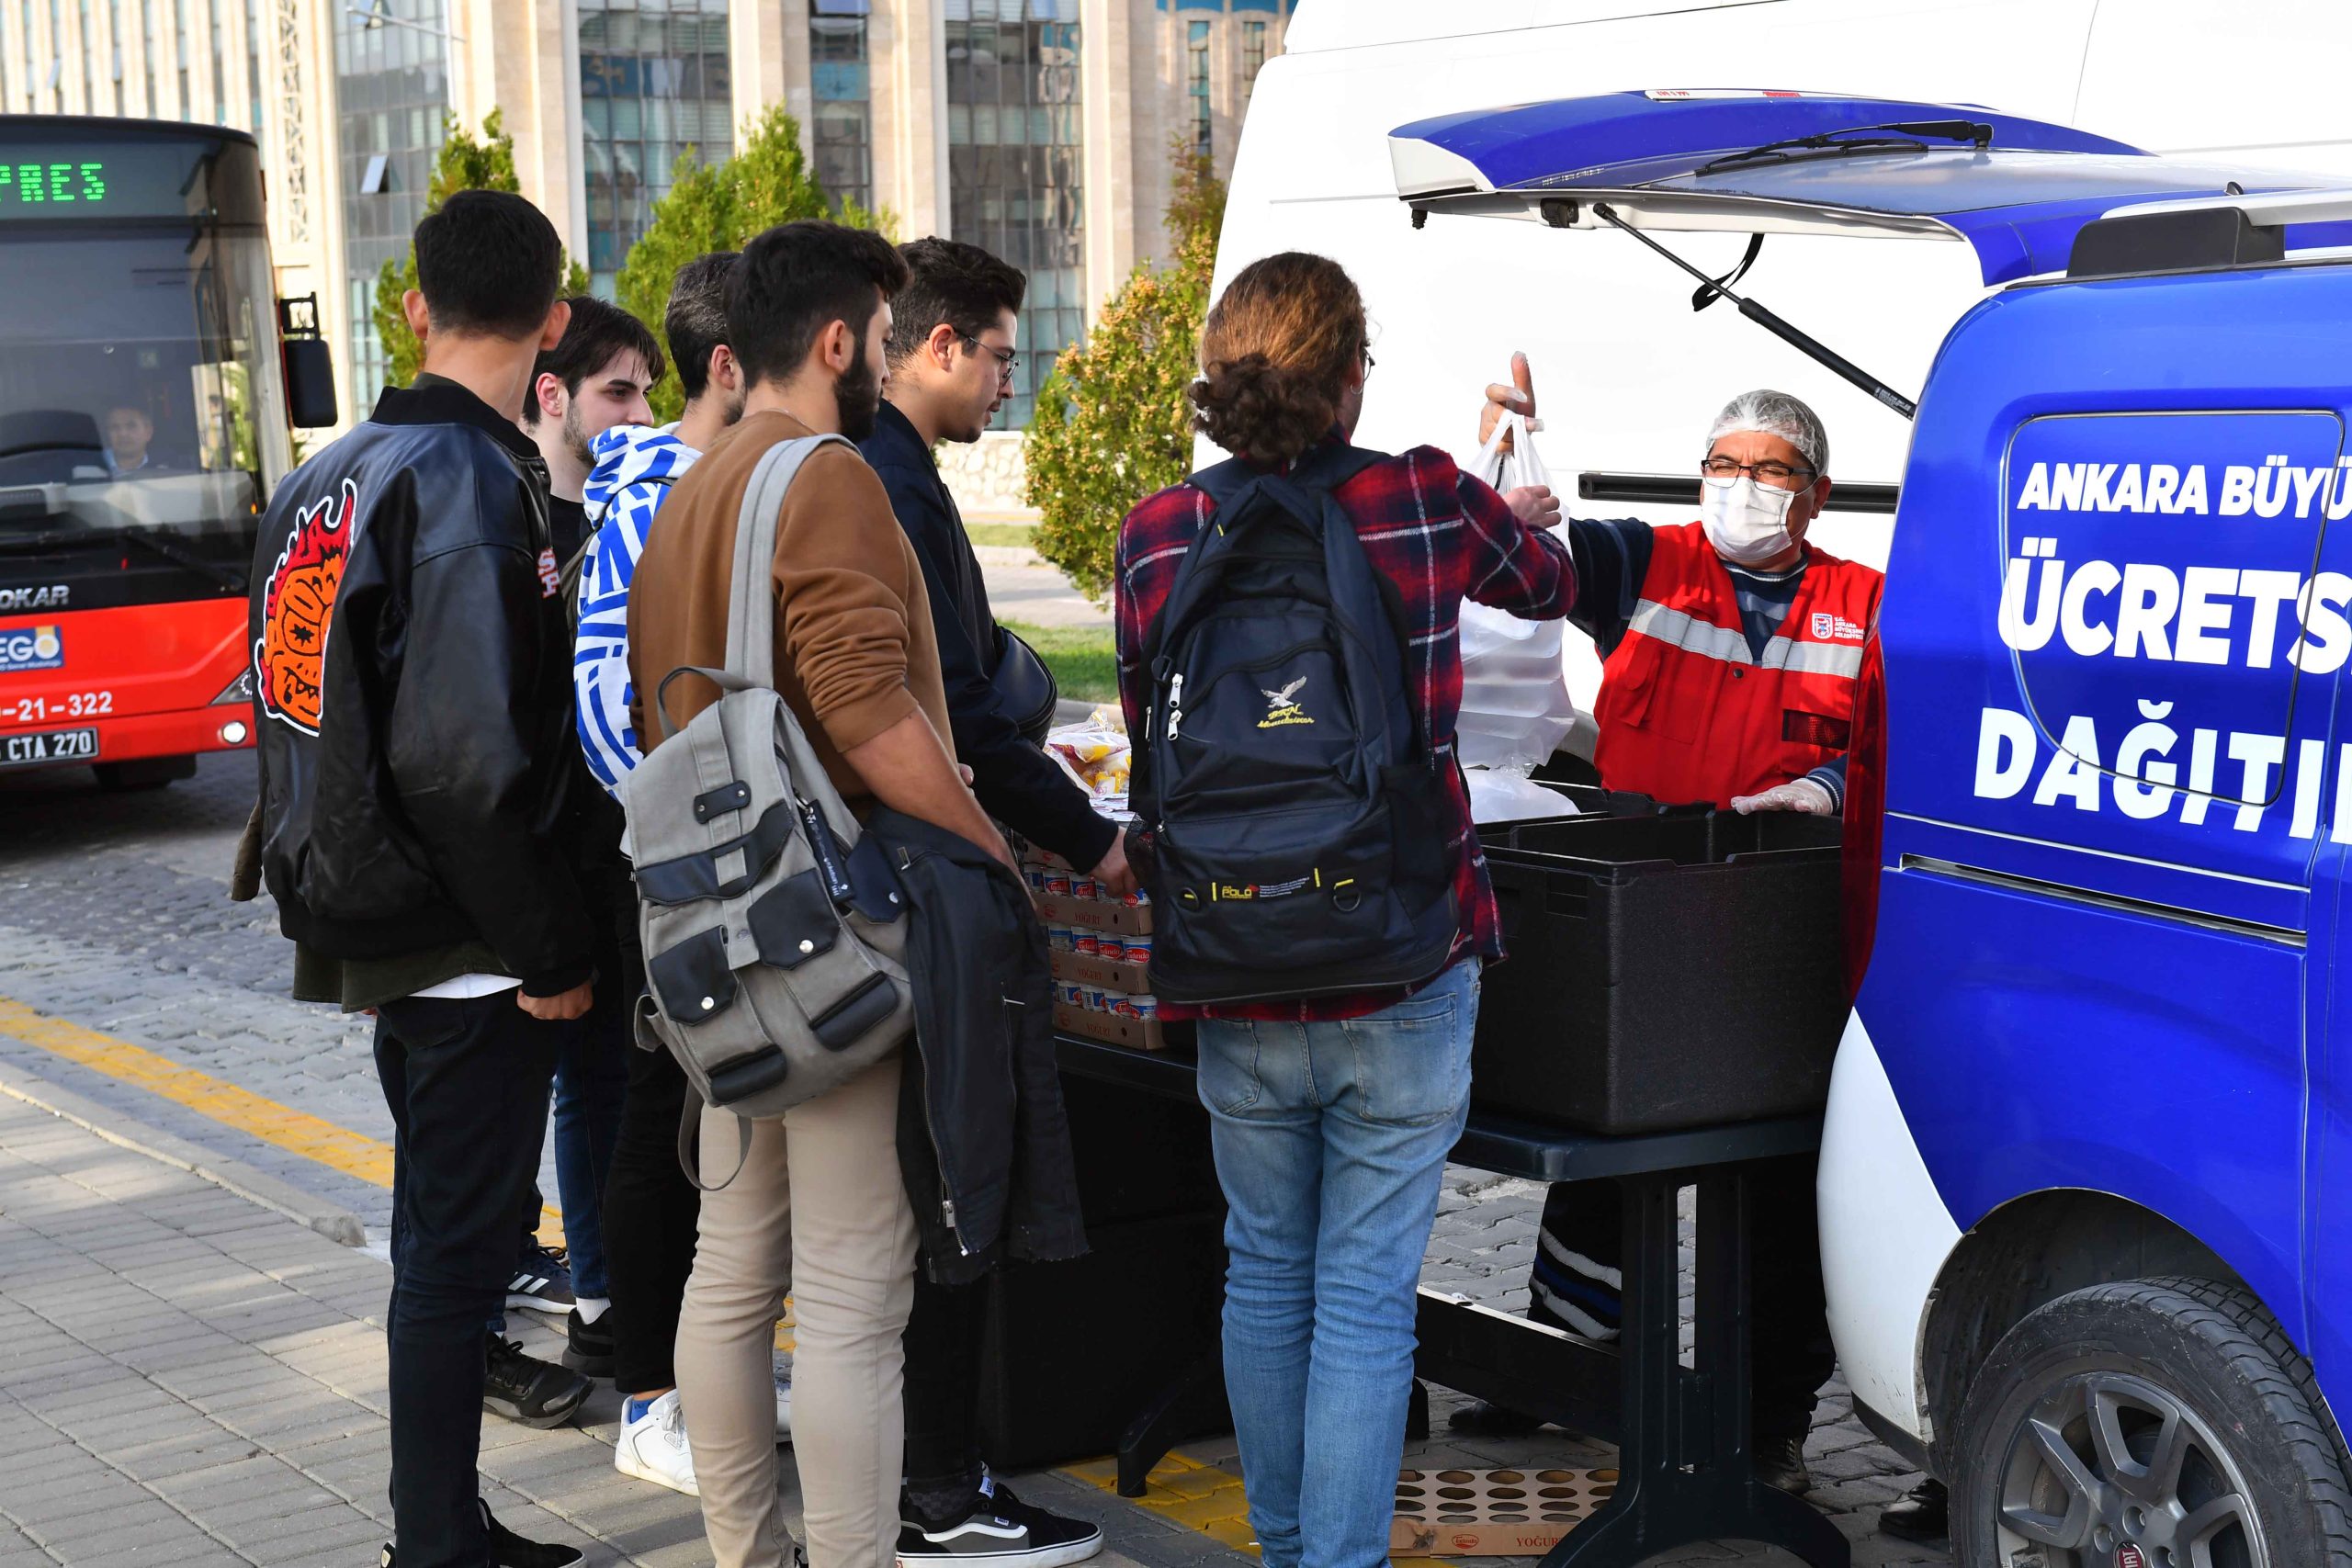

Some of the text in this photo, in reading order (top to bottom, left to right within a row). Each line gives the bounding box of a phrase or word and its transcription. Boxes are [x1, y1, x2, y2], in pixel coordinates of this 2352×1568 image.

[2017, 455, 2352, 520] ANKARA BÜYÜ
[1997, 536, 2352, 675] ÜCRETS
[7, 730, 92, 761] CTA 270
[1222, 888, 1252, 897] POLO
[1516, 1535, 1562, 1547] YOĞUR
